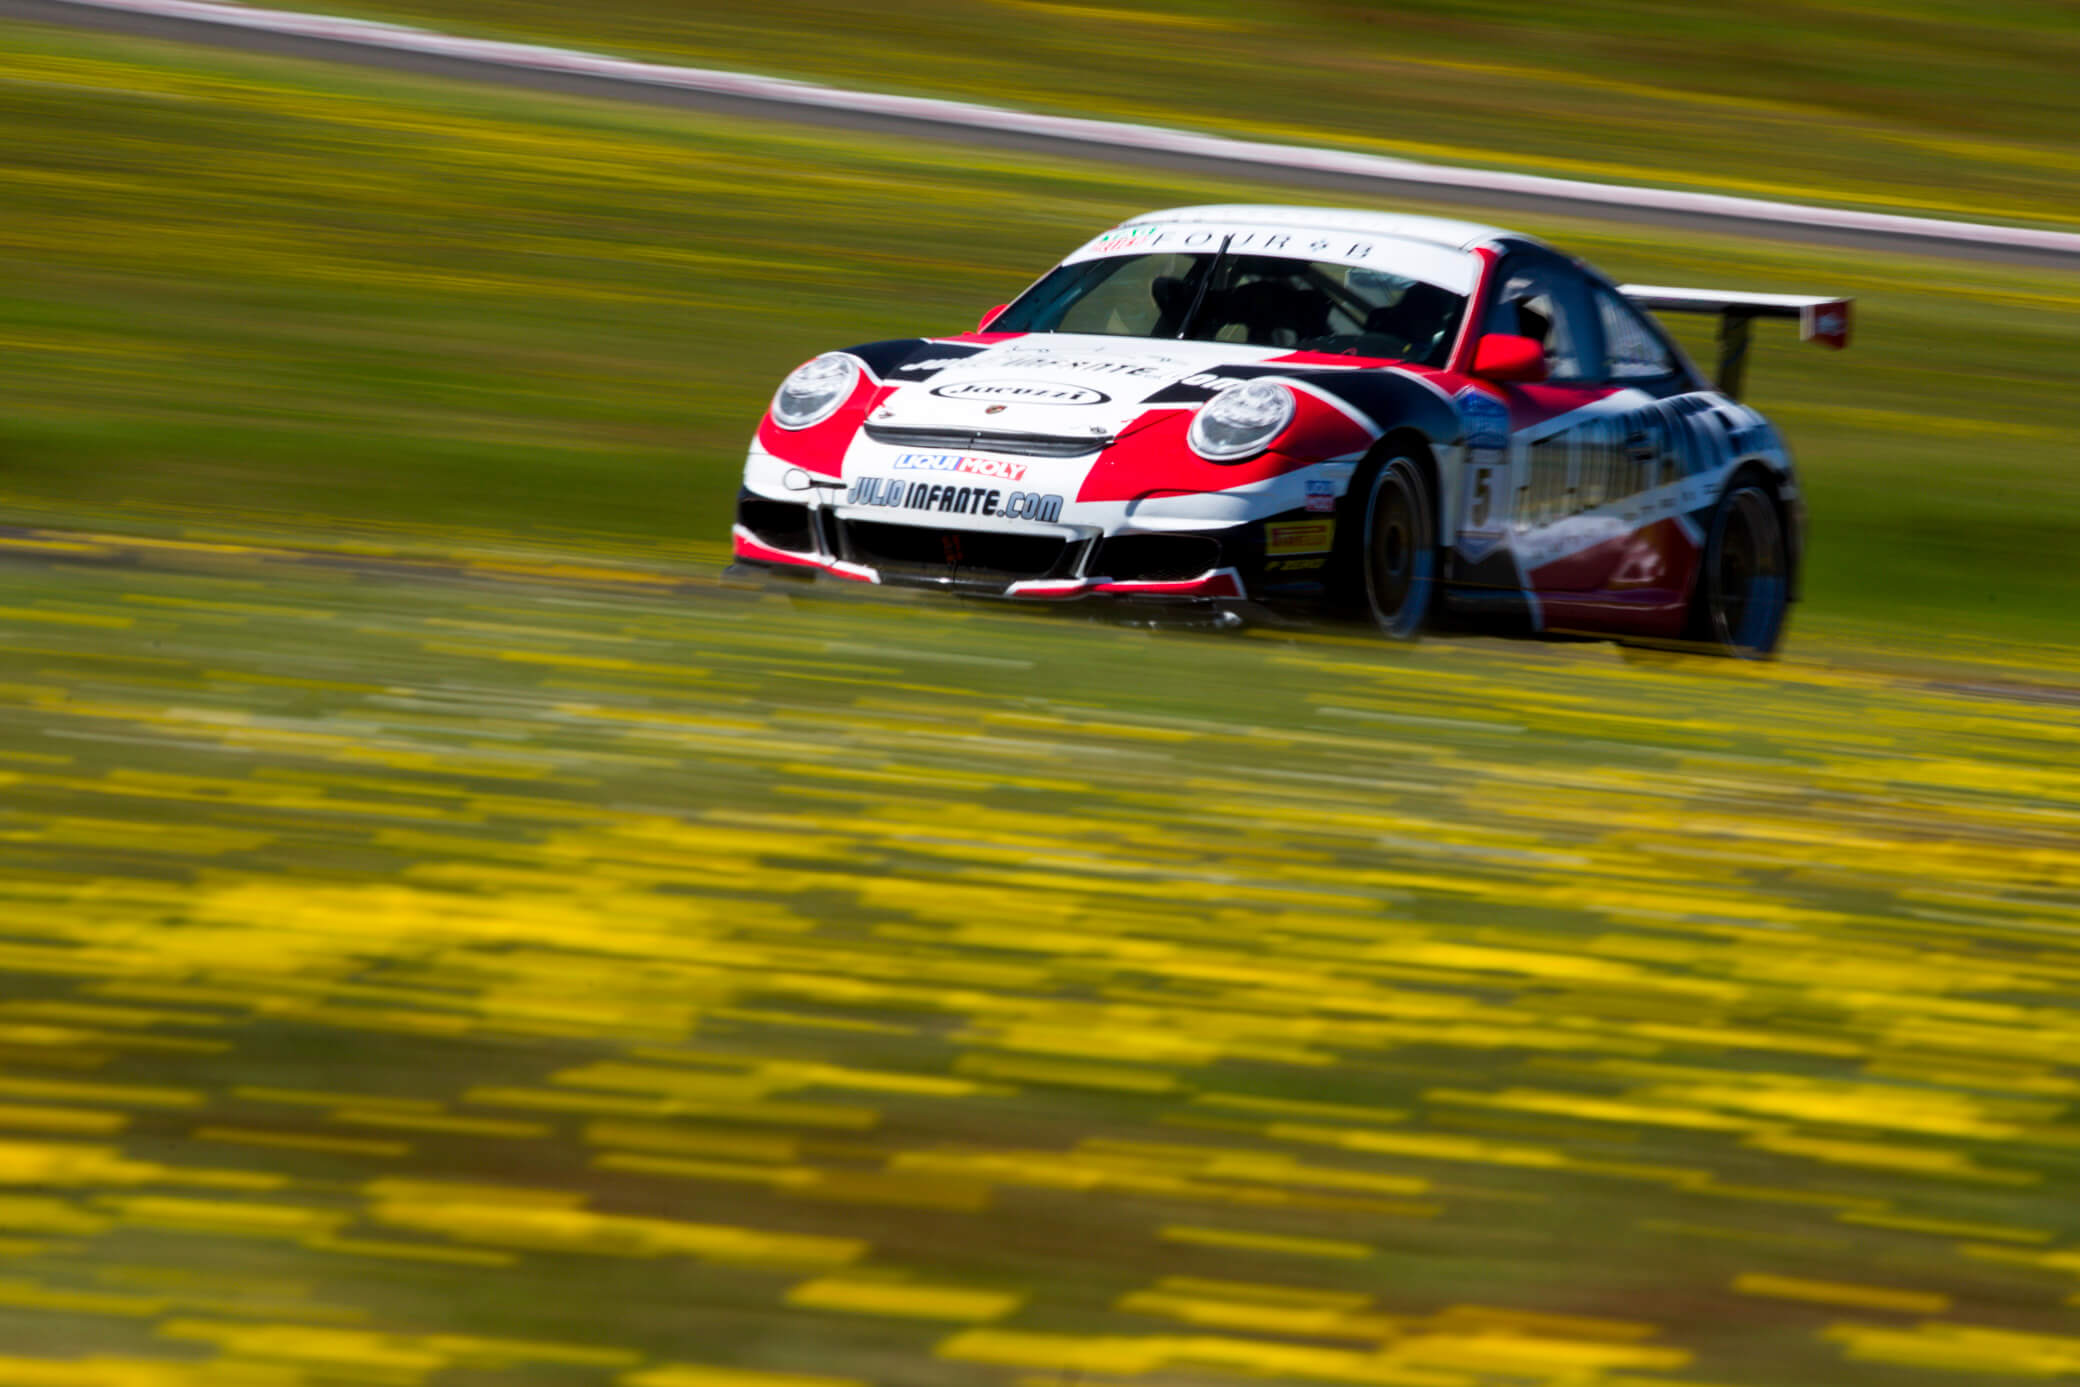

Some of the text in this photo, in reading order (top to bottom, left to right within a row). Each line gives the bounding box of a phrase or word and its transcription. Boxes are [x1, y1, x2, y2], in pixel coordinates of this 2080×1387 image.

[1151, 231, 1291, 249] FOUR
[950, 383, 1088, 400] Jacuzzi
[896, 455, 1024, 480] LIQUI MOLY
[1471, 467, 1492, 528] 5
